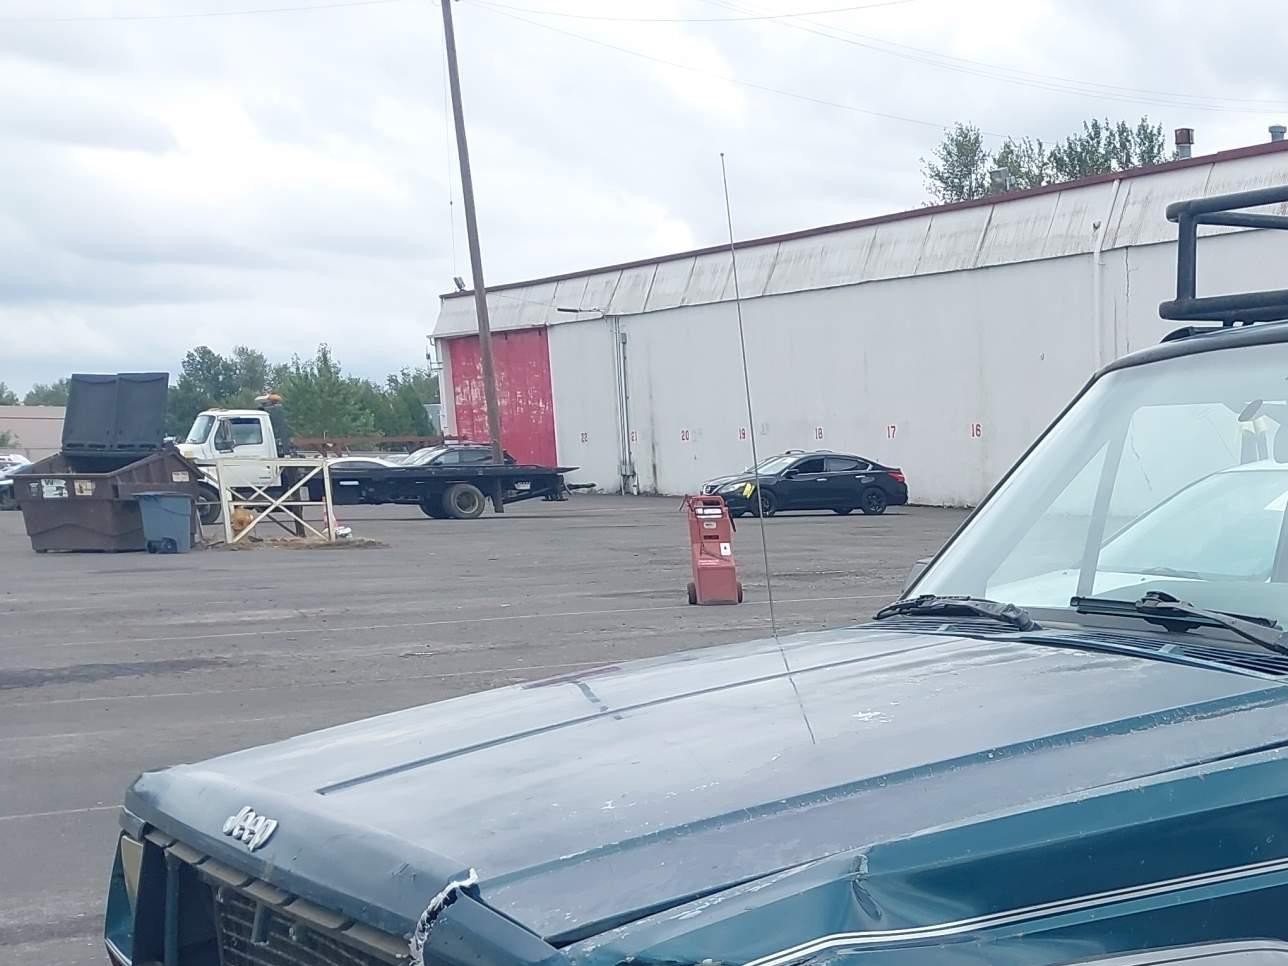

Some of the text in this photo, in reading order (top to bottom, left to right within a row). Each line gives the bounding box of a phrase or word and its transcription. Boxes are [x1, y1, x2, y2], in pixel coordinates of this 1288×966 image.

[631, 431, 638, 442] 21
[681, 430, 690, 441] 20
[738, 428, 746, 440] 19
[815, 427, 823, 440] 18
[887, 425, 896, 439] 17
[970, 423, 981, 438] 16
[223, 806, 279, 852] Jeep
